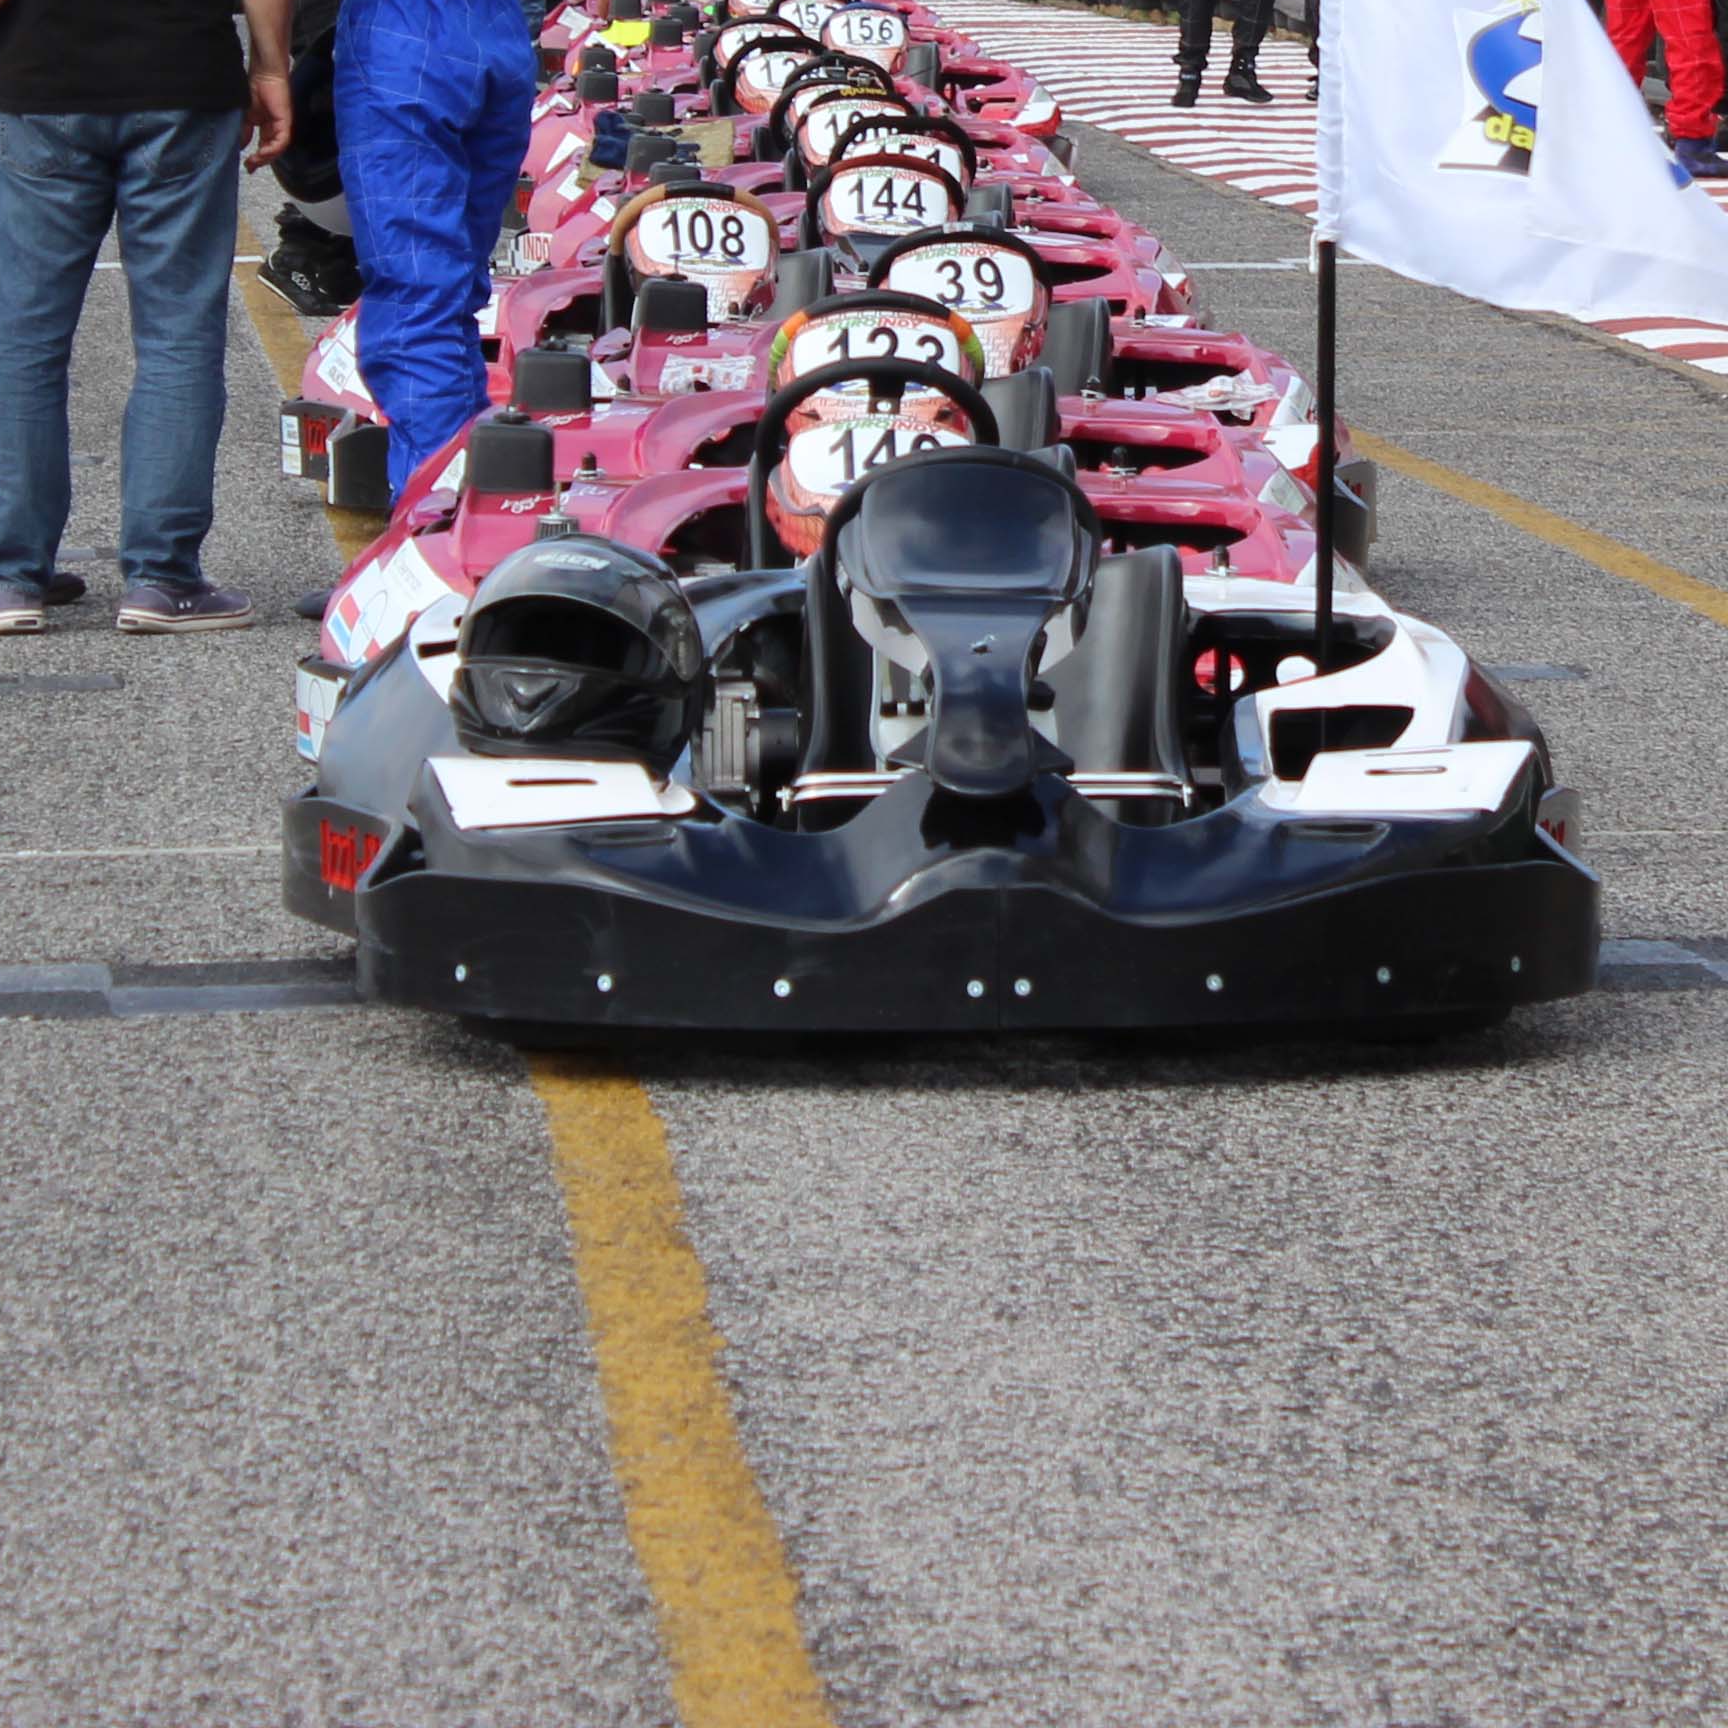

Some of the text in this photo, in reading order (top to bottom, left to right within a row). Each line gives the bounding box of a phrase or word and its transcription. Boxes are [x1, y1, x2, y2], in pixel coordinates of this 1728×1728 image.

[840, 16, 895, 46] 156
[848, 177, 927, 217] 144
[662, 210, 745, 257] 108
[935, 256, 1005, 304] 39
[826, 316, 921, 332] EUROINDY
[827, 326, 944, 367] 123
[834, 420, 941, 434] EUROINDY
